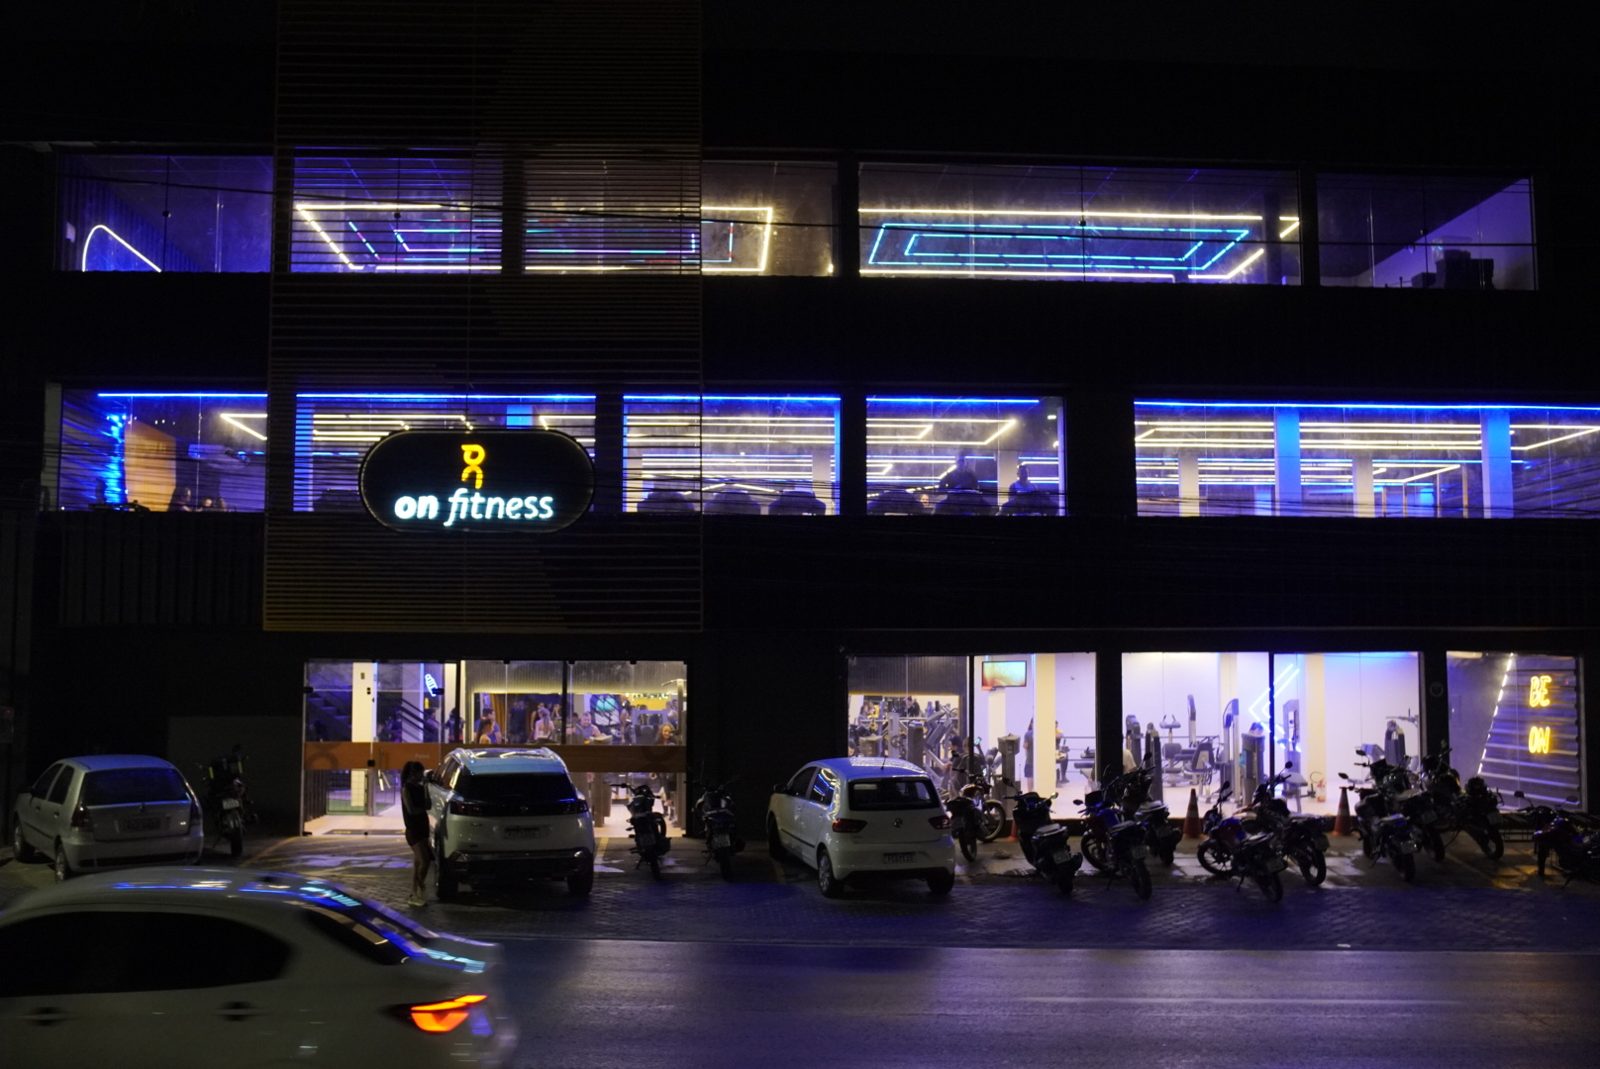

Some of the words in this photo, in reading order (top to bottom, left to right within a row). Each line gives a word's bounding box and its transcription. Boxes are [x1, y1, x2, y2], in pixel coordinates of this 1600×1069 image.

[394, 494, 439, 520] on
[443, 487, 554, 527] fitness
[1529, 675, 1552, 708] BE
[1528, 726, 1551, 754] ON
